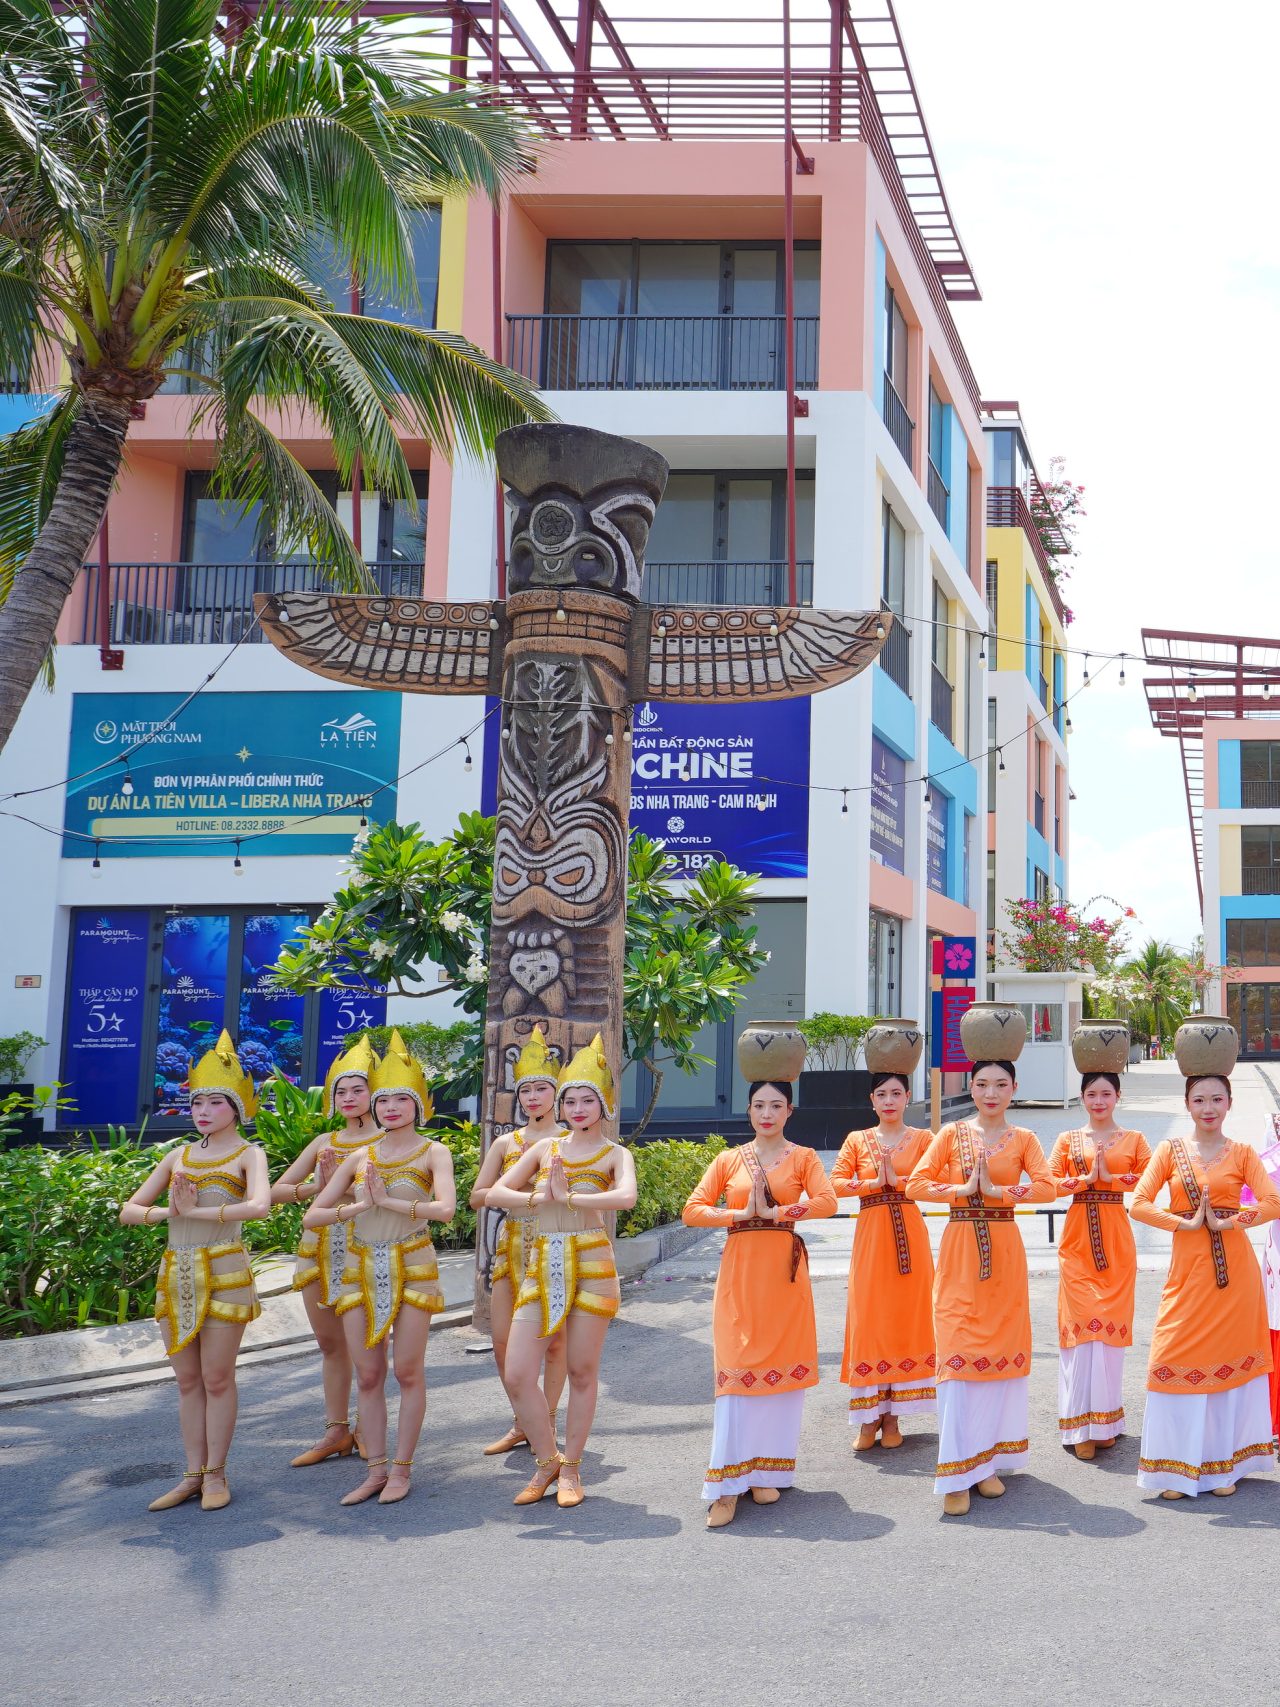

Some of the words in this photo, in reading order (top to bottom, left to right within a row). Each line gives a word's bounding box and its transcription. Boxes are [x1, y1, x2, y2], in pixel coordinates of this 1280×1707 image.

[173, 733, 202, 743] NAM
[320, 731, 339, 741] LA
[344, 730, 377, 741] TIÊN
[632, 736, 656, 749] HẦN
[659, 736, 684, 748] BẤT
[687, 736, 725, 750] ĐỘNG
[727, 735, 753, 748] SẢN
[631, 752, 753, 780] CHINE
[154, 775, 178, 788] ĐƠN
[181, 775, 192, 789] VỊ
[194, 774, 227, 788] PHÂN
[228, 772, 255, 787] PHỐI
[257, 773, 291, 787] CHÍNH
[294, 772, 324, 787] THỨC
[87, 795, 110, 813] DỰ
[110, 793, 131, 810] ÁN
[132, 795, 151, 810] LA
[154, 792, 185, 809] TIÊN
[188, 794, 227, 809] VILLA
[241, 794, 288, 809] LIBERA
[292, 794, 323, 808] NHA
[326, 793, 373, 808] TRANG
[647, 795, 670, 809] NHA
[672, 794, 709, 809] TRANG
[719, 794, 744, 809] CAM
[176, 821, 219, 831] HOTLINE:
[221, 820, 285, 831] 08.2332.8888
[87, 1004, 106, 1033] 5
[337, 1001, 356, 1030] 5
